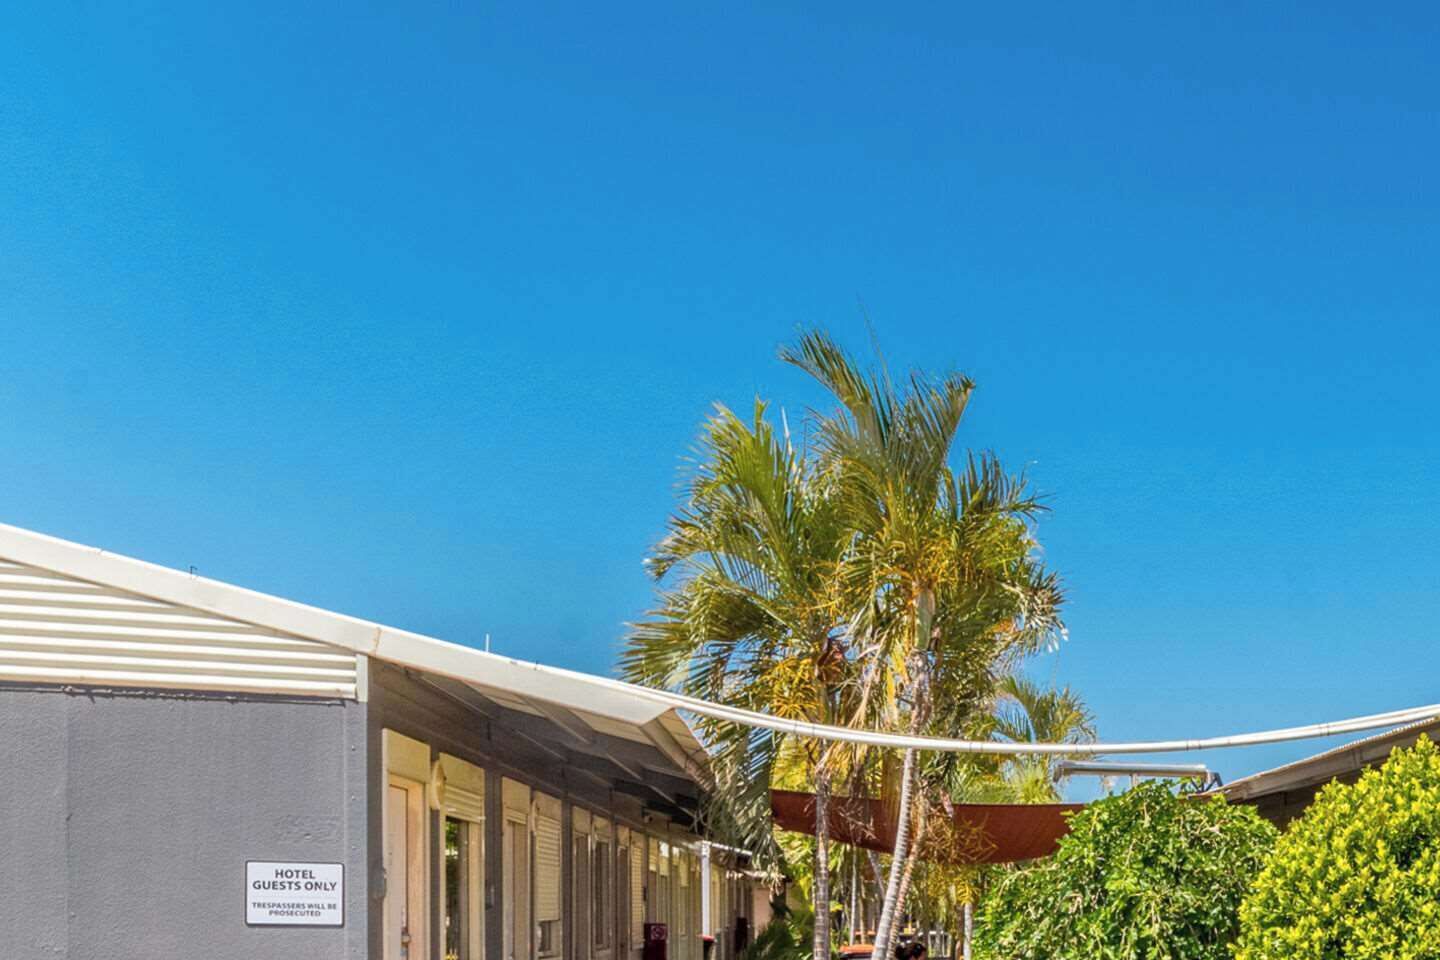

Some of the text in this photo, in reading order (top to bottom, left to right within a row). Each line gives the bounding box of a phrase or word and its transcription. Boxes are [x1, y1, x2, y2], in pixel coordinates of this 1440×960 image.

[275, 869, 316, 879] HOTEL
[252, 880, 337, 891] GUESTS ONLY
[252, 902, 306, 910] TRESPASSERS
